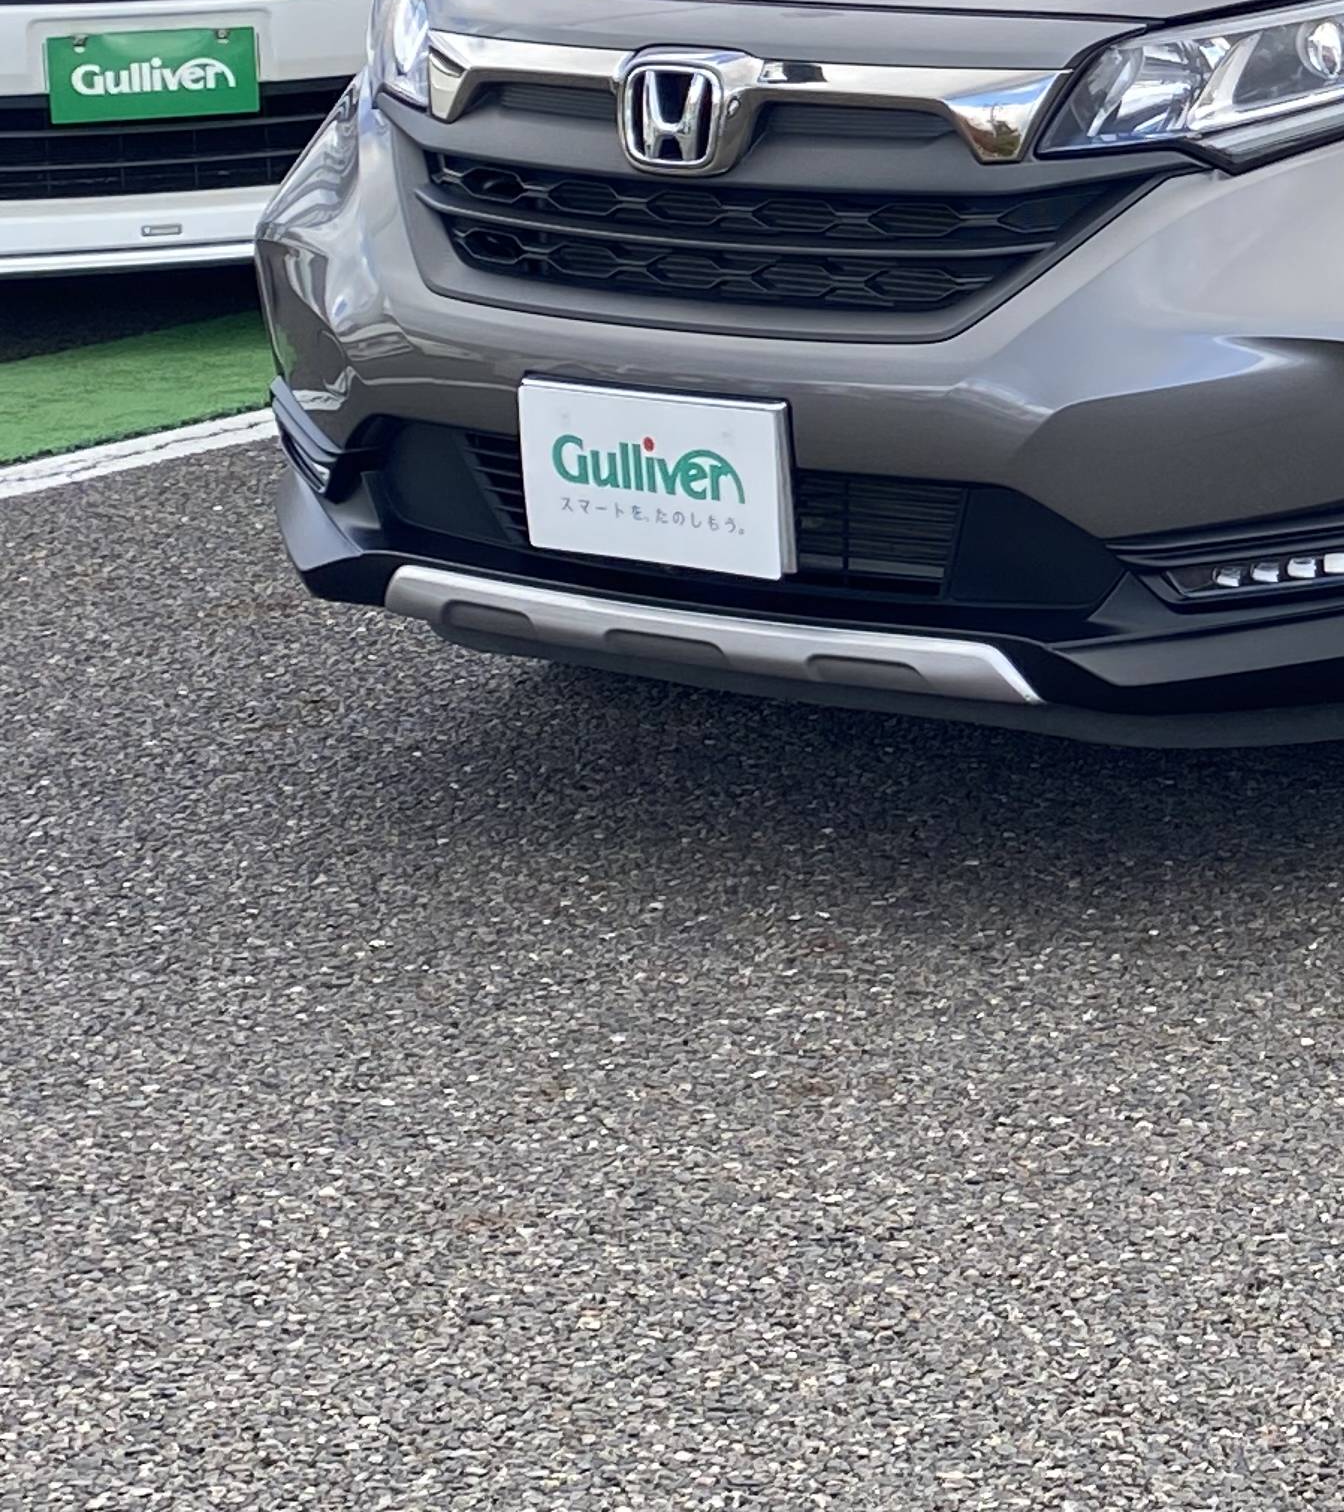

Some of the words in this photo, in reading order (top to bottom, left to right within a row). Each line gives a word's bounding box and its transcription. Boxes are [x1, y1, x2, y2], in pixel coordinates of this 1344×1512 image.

[71, 57, 236, 96] Gulliver
[552, 434, 746, 505] Gulliver
[560, 495, 746, 536] スマートを、たのしもう。
